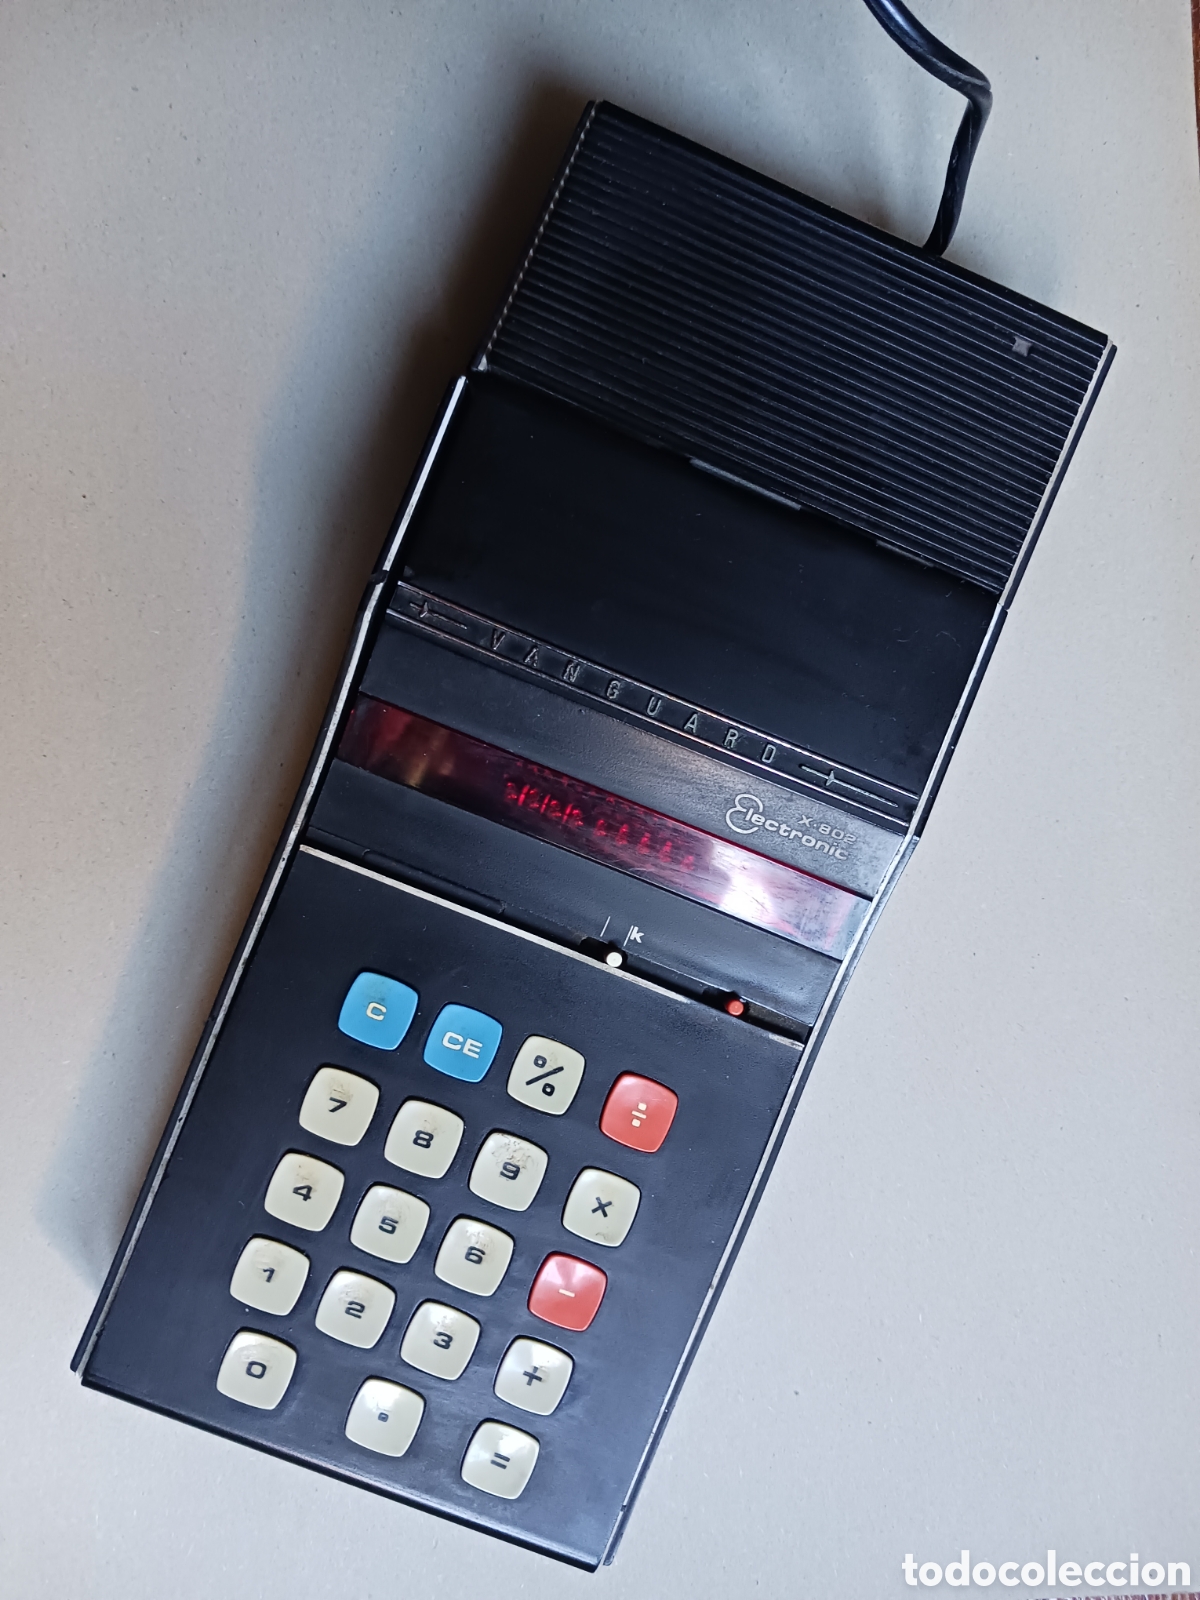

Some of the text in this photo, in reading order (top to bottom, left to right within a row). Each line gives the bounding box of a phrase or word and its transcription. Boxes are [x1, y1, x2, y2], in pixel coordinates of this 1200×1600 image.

[490, 628, 777, 764] VANGUARD
[725, 793, 849, 861] Electronic
[366, 1001, 387, 1021] C
[441, 1031, 483, 1060] CE
[524, 1054, 565, 1097] %
[327, 1097, 348, 1114] 7
[412, 1129, 434, 1149] 8
[499, 1161, 521, 1181] 9
[292, 1184, 313, 1203] 4
[378, 1215, 399, 1235] 5
[464, 1245, 486, 1265] 6
[261, 1266, 276, 1283] 1
[344, 1300, 366, 1319] 2
[432, 1331, 453, 1350] 3
[522, 1365, 543, 1387] +
[489, 1451, 511, 1471] =
